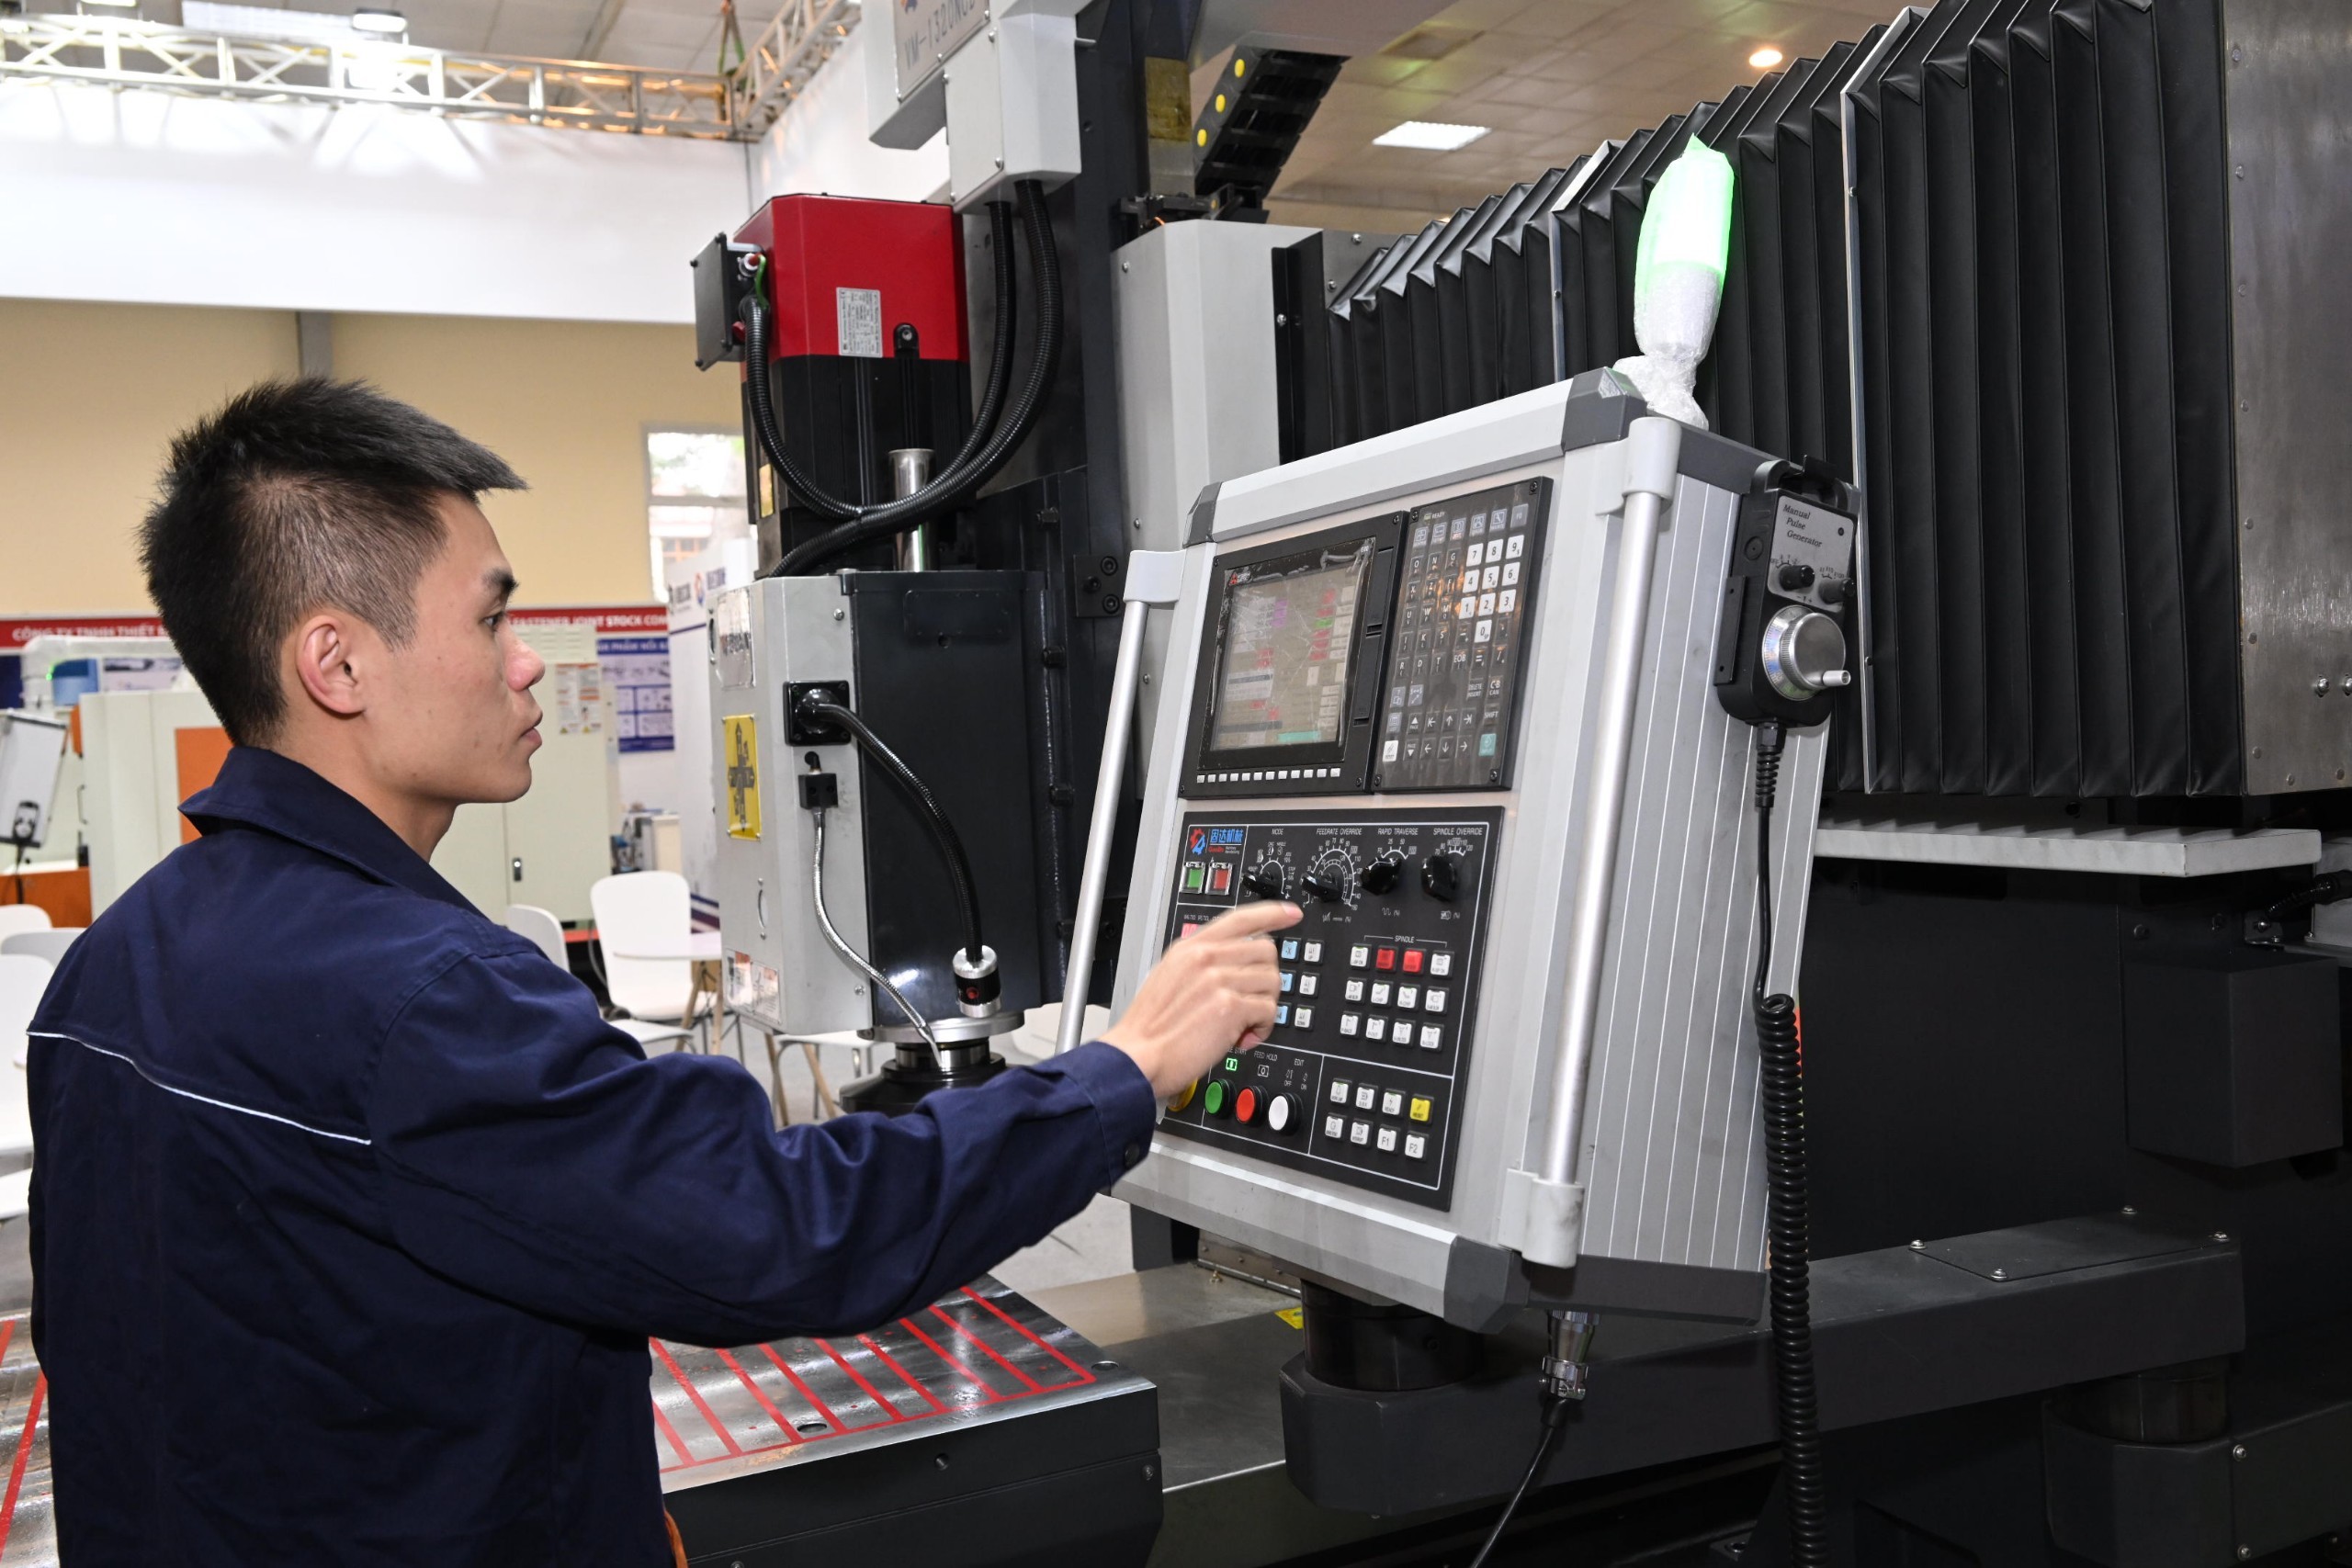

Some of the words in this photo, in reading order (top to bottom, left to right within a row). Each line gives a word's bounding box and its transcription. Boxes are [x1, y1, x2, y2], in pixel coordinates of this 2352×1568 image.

[1783, 504, 1811, 520] Manual
[1786, 517, 1805, 530] Pulse
[1787, 530, 1823, 547] Generator
[1491, 547, 1497, 556] 8
[1512, 543, 1517, 552] 9
[1473, 550, 1477, 558] 7
[1488, 573, 1493, 581] 5
[1509, 570, 1513, 579] 6
[1468, 577, 1473, 585] 4
[1484, 600, 1488, 609] 2
[1504, 596, 1509, 606] 3
[1424, 607, 1431, 615] W
[1465, 603, 1469, 612] 1
[605, 615, 642, 627] STOCK
[1453, 654, 1466, 662] EOB
[1395, 935, 1414, 943] SPINDLE
[1254, 1050, 1265, 1059] FEED
[1266, 1053, 1278, 1061] HOLD
[1382, 1137, 1389, 1146] F1
[1409, 1143, 1418, 1154] F2
